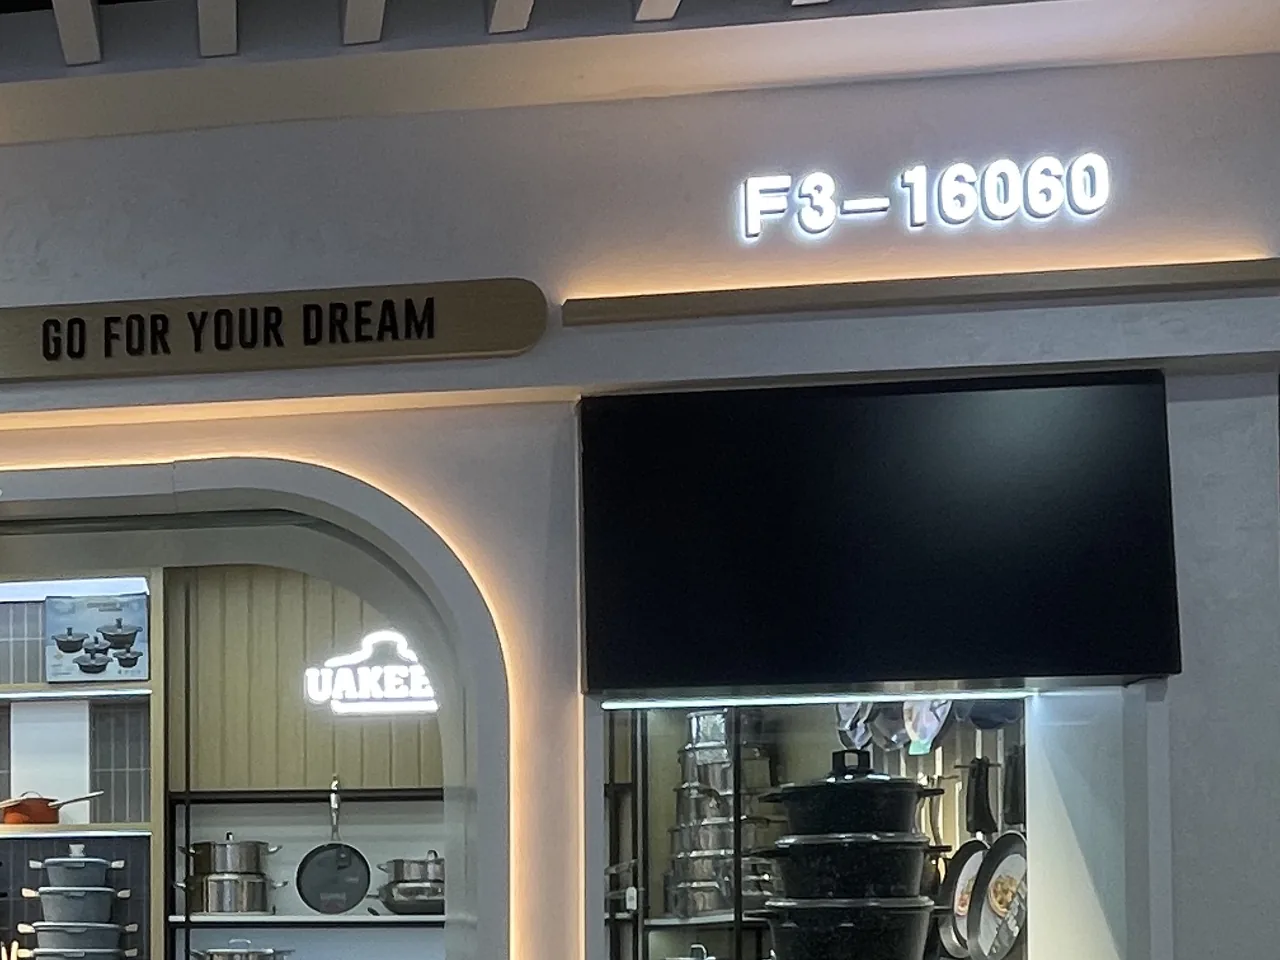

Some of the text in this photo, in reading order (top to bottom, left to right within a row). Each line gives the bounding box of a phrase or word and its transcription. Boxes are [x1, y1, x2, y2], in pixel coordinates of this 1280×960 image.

[744, 151, 1110, 238] F3-16060
[41, 296, 436, 361] GO FOR YOUR DREAM
[304, 664, 436, 702] UAKEE
